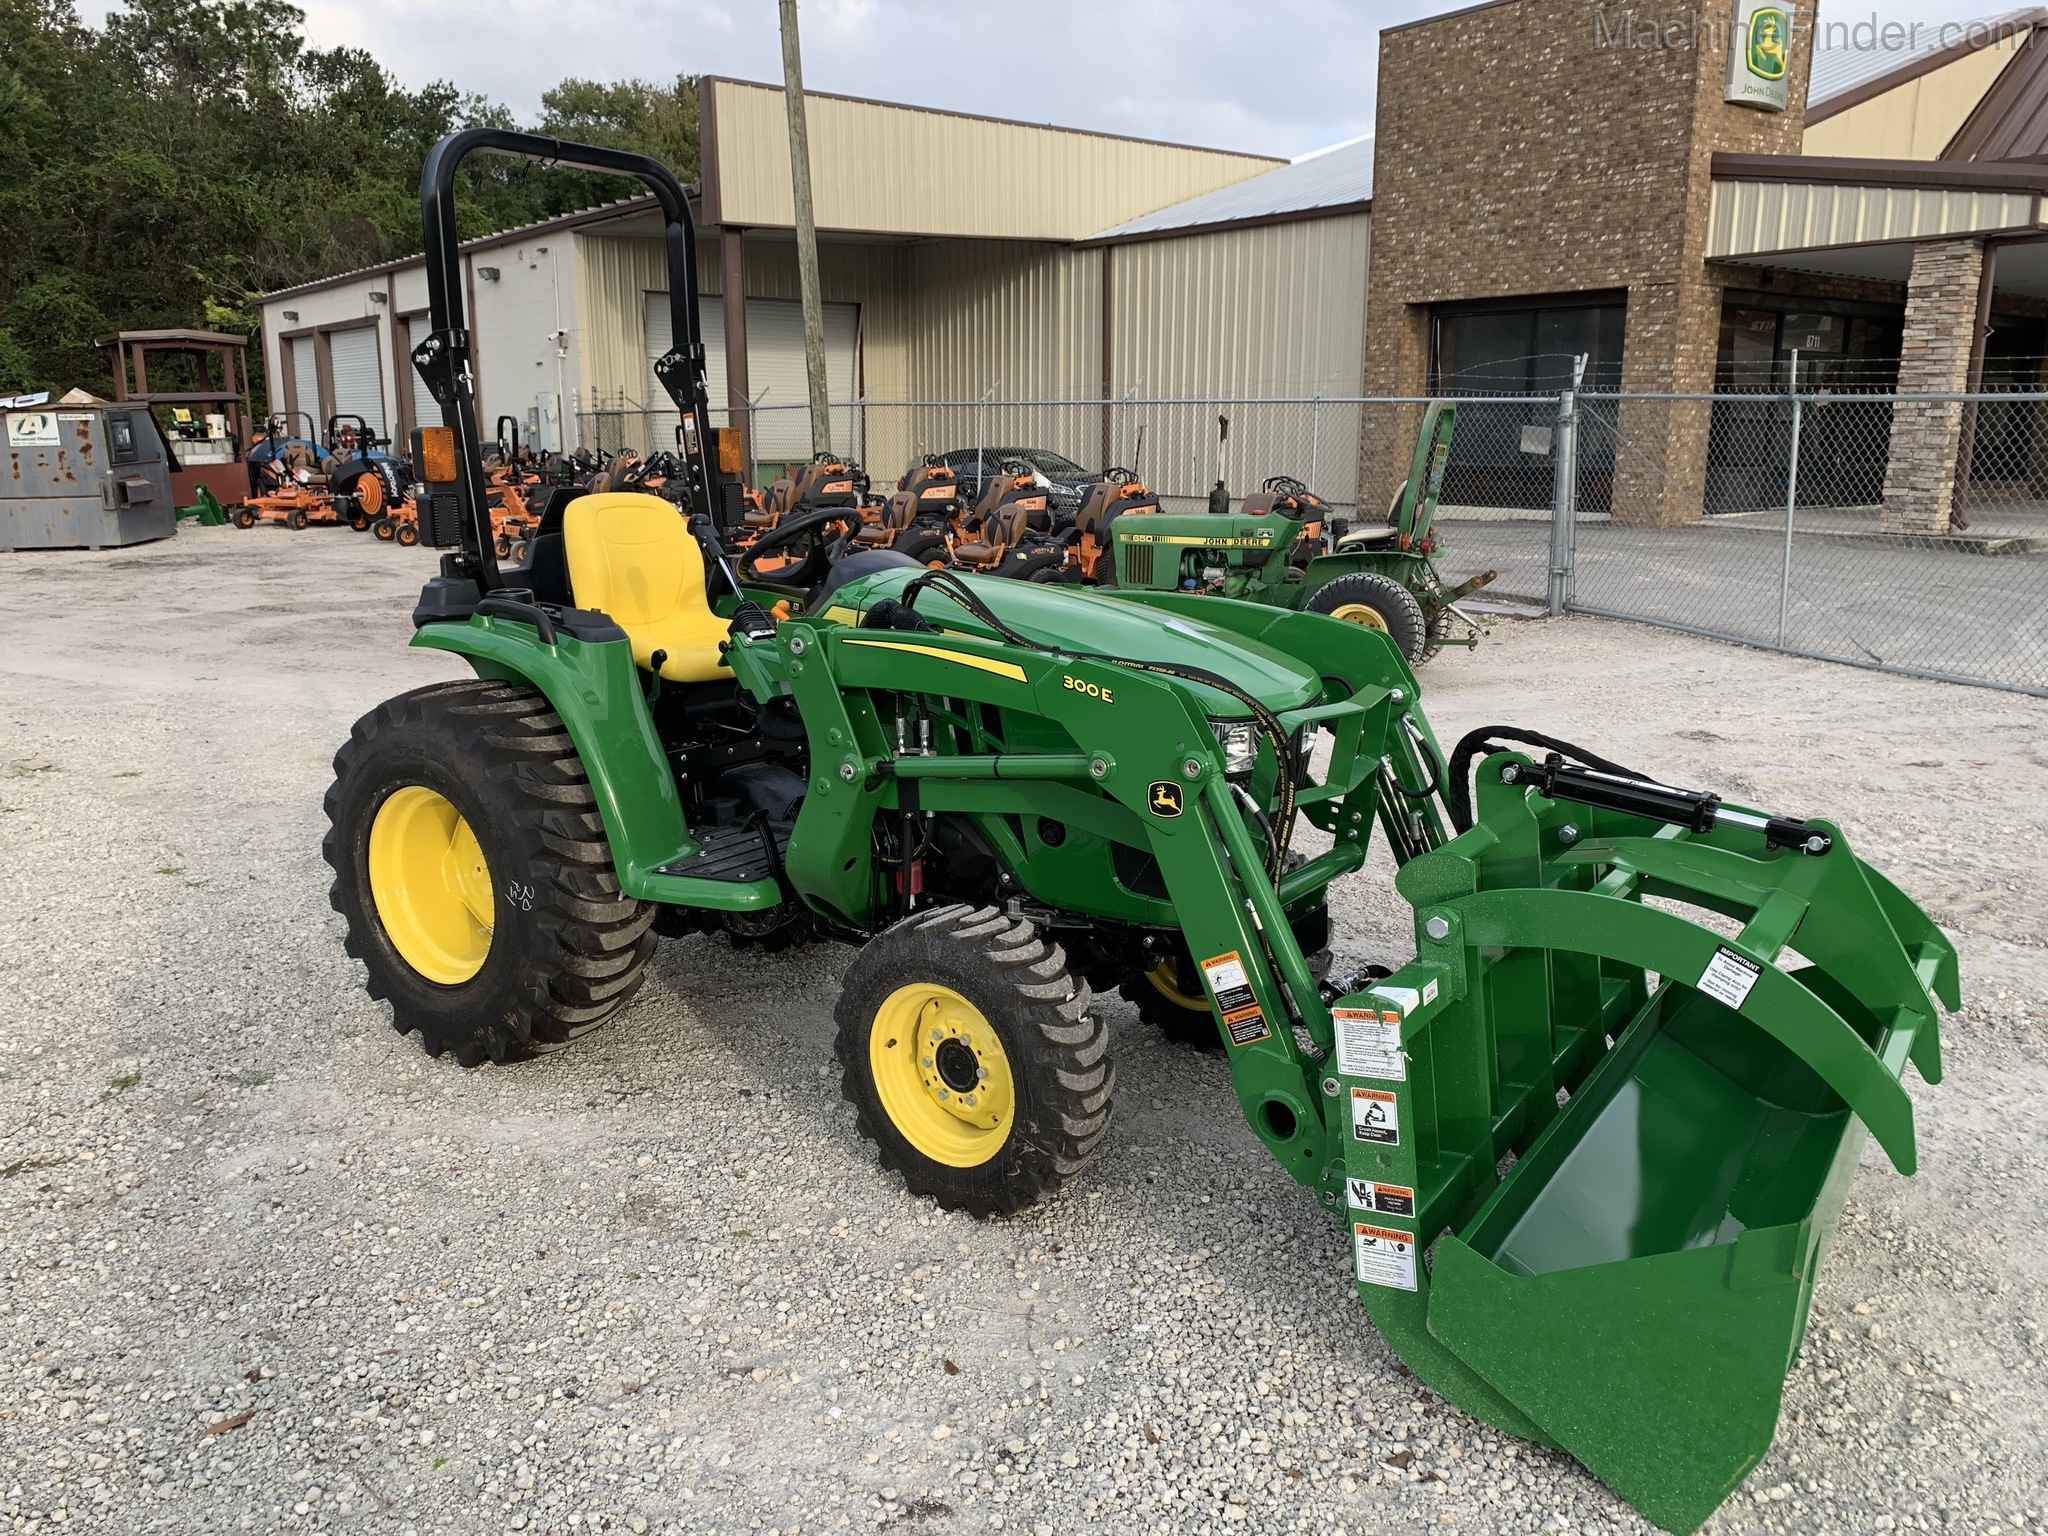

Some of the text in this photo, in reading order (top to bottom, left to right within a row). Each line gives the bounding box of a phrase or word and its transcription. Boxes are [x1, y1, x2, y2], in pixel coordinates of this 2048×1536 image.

[1741, 84, 1764, 96] JOHN
[1806, 335, 1820, 348] 8711
[1211, 954, 1234, 965] WARNING
[1720, 947, 1760, 972] IMPORTANT
[1718, 972, 1732, 980] Clamp
[1736, 966, 1753, 978] Machine
[1361, 1092, 1392, 1101] WARNING
[1369, 1230, 1408, 1241] WARNING
